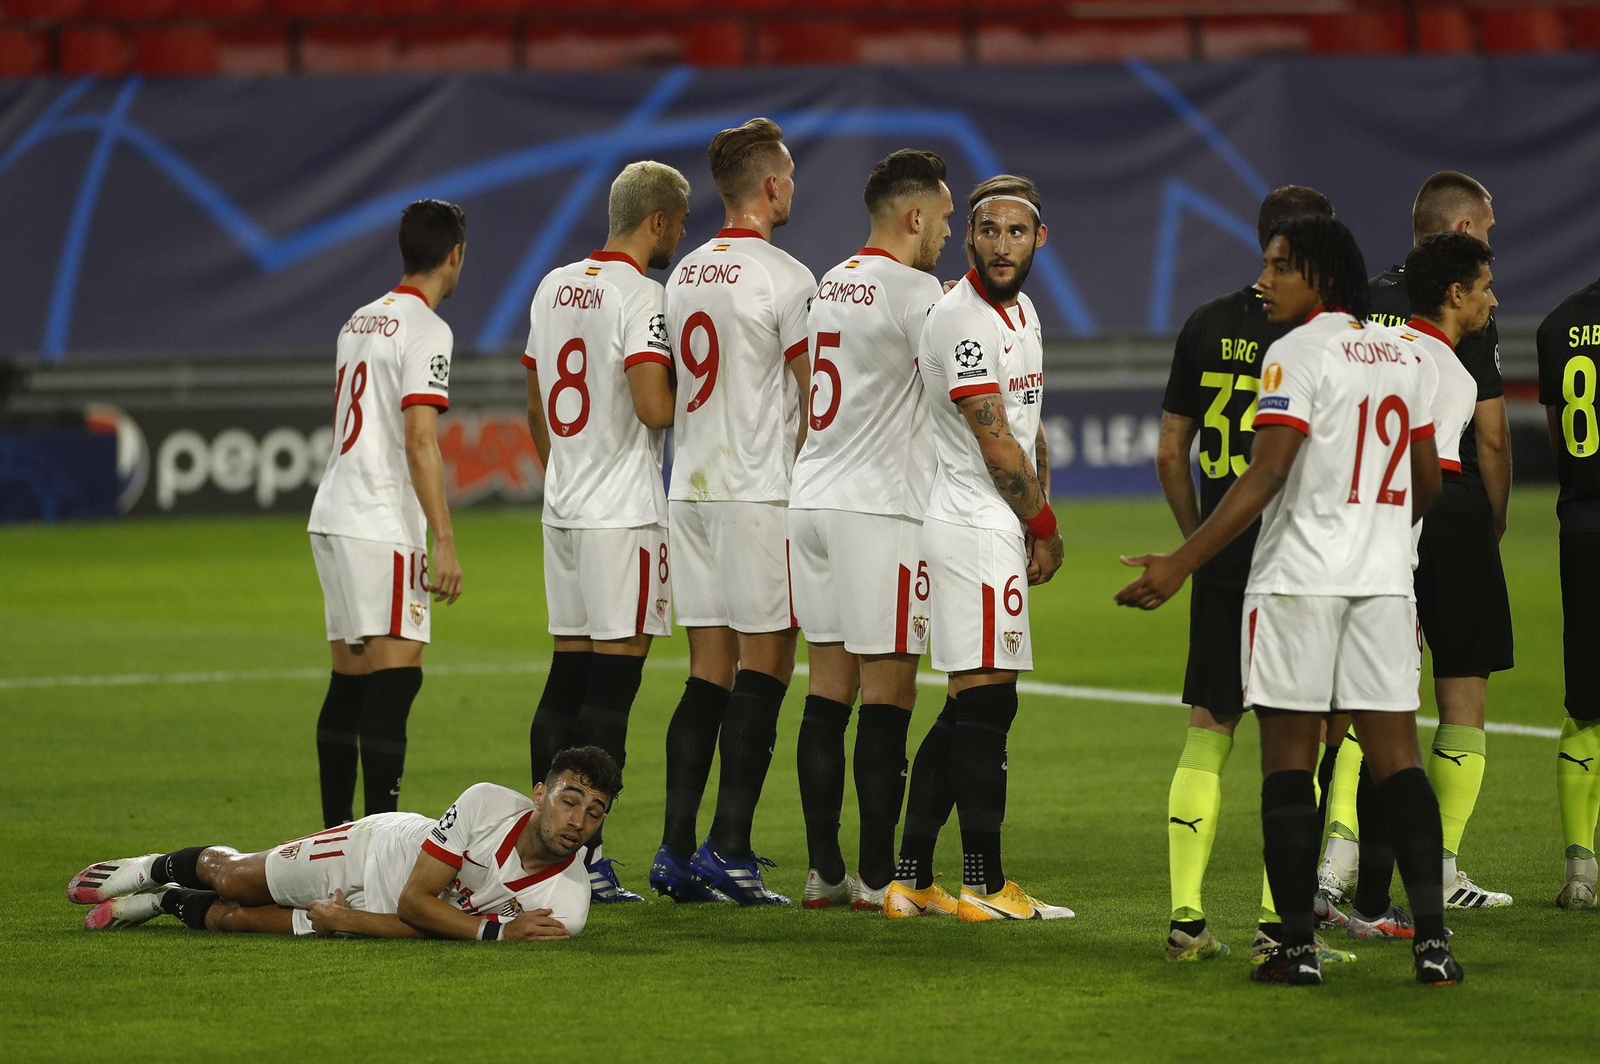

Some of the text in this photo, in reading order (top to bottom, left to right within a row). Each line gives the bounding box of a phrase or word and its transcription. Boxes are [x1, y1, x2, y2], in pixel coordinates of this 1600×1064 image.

[678, 264, 741, 287] DE JONG
[344, 315, 399, 337] SCUDRO
[1367, 313, 1406, 327] TKIN
[1568, 325, 1600, 348] SAB
[680, 311, 719, 412] 9
[809, 331, 842, 431] 5
[333, 361, 367, 456] 18
[548, 337, 591, 438] 8
[1562, 355, 1600, 458] 8
[1199, 371, 1261, 479] 33
[1346, 394, 1410, 506] 12
[410, 551, 429, 593] 18
[658, 542, 669, 584] 8
[915, 560, 930, 601] 5
[1003, 574, 1023, 616] 6
[309, 835, 348, 862] 11
